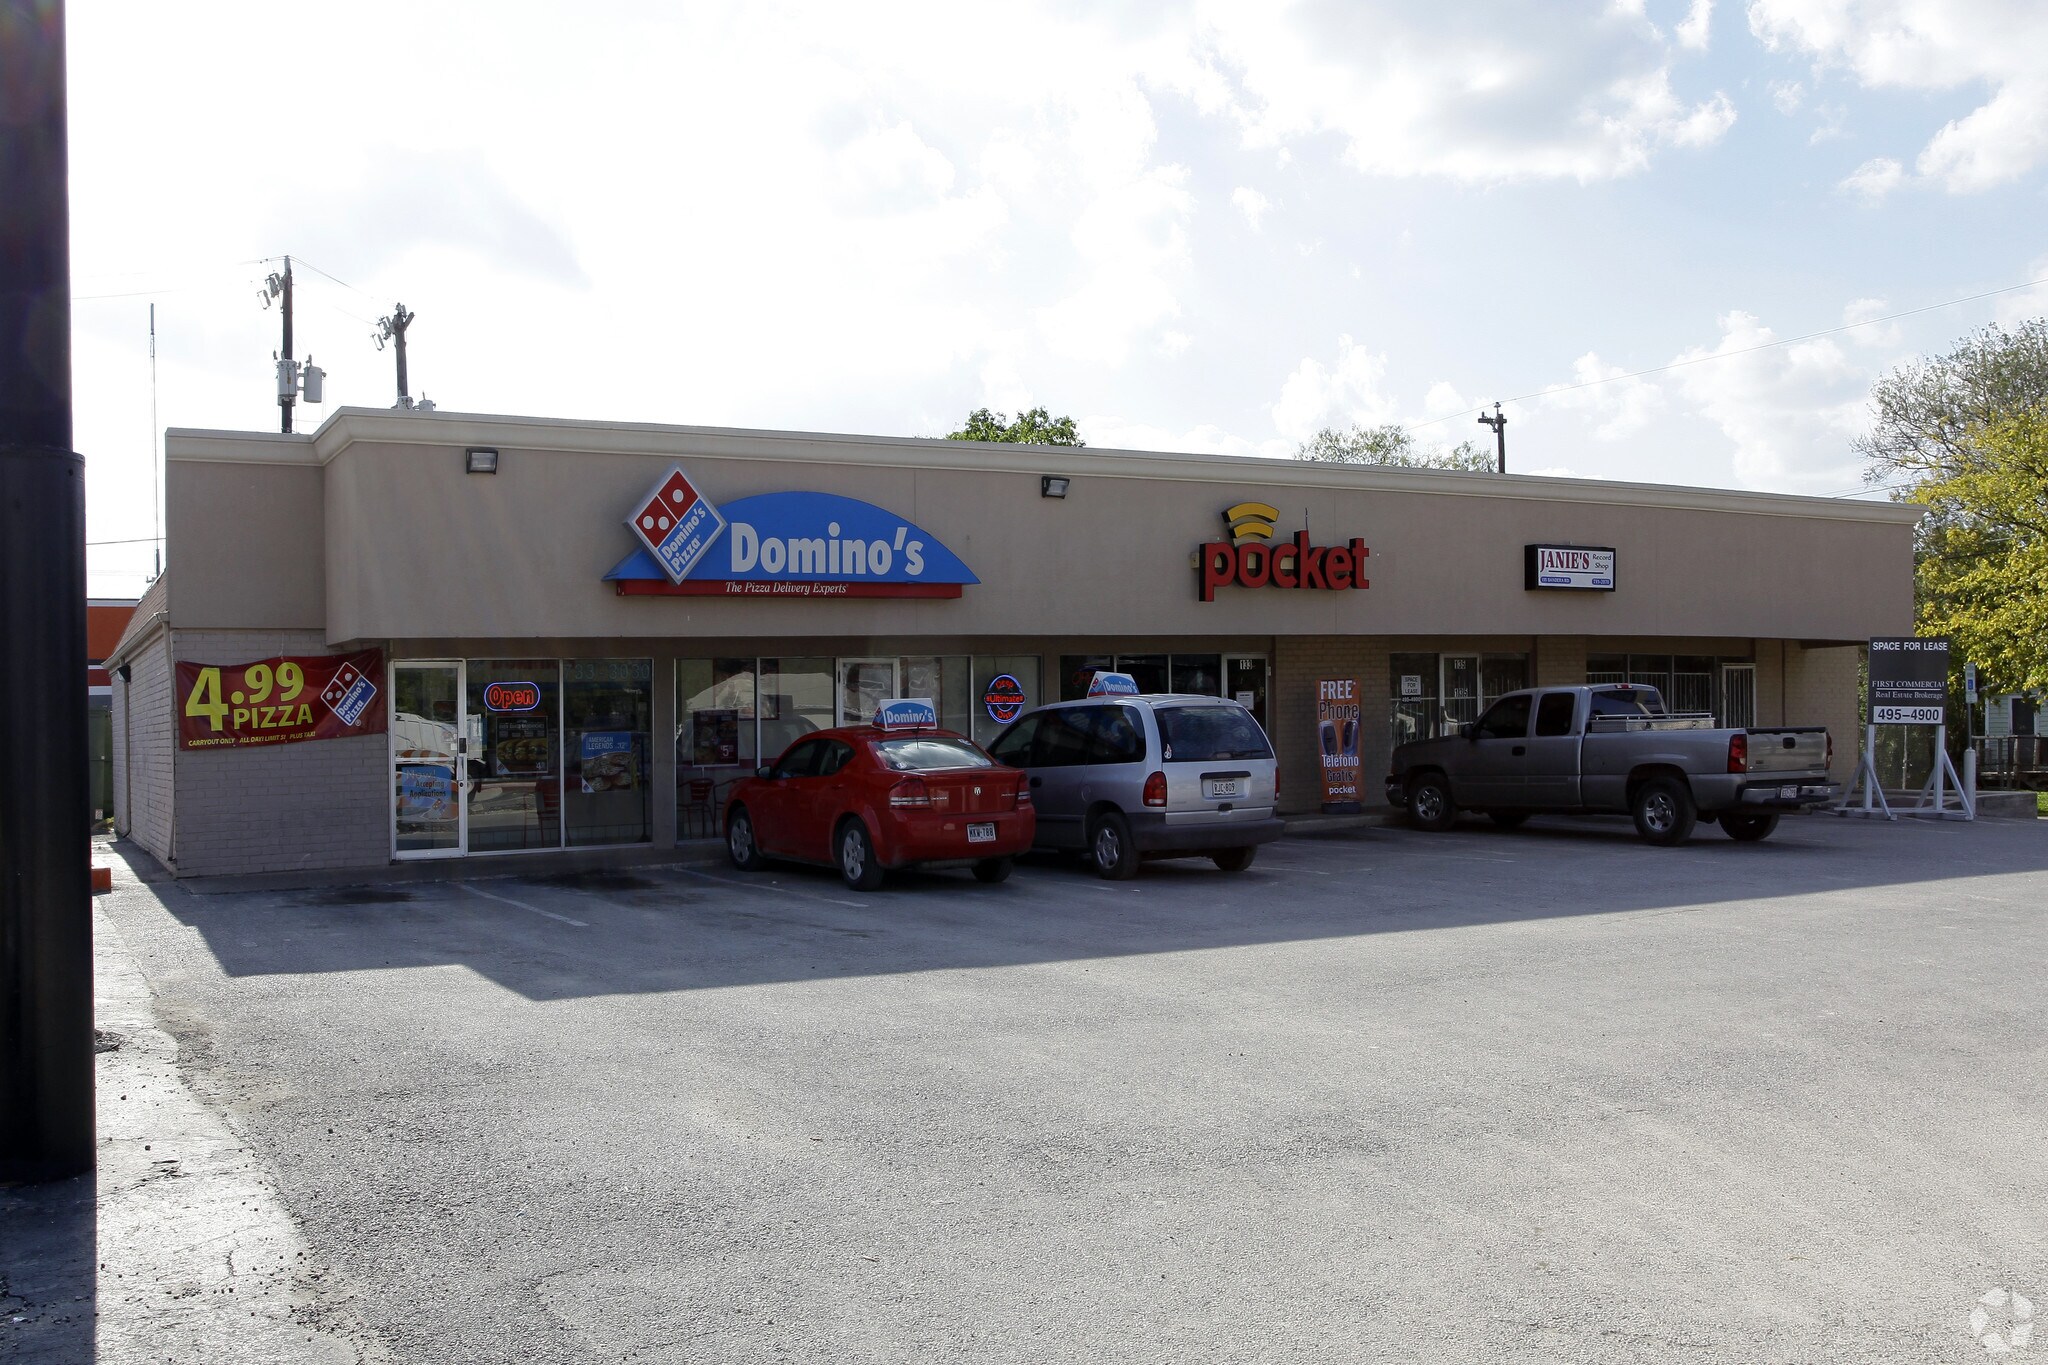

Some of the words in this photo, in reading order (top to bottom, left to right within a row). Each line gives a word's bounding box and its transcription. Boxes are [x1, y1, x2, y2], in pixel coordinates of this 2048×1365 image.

[660, 506, 706, 560] Domino's
[669, 535, 701, 573] Pizza
[731, 521, 925, 576] Domino's
[1540, 550, 1590, 572] JANIE'S
[1592, 553, 1612, 561] Record
[1199, 530, 1369, 602] pocket
[1594, 562, 1609, 570] Shop
[725, 582, 742, 593] The
[744, 582, 770, 593] Pizza
[773, 582, 810, 596] Delivery
[812, 583, 848, 595] Experts
[1872, 641, 1900, 651] SPACE
[1903, 642, 1921, 651] FOR
[1923, 642, 1948, 651] LEASE
[1104, 680, 1138, 694] Domino's
[1320, 680, 1353, 700] FREE
[185, 661, 305, 732] 4.99
[337, 681, 366, 716] Domino's
[489, 685, 534, 708] Open
[1914, 691, 1943, 700] Brokerage
[233, 703, 314, 730] PIZZA
[344, 699, 364, 722] Pizza
[886, 709, 934, 724] Domino's
[997, 710, 1014, 720] Dish
[1320, 701, 1360, 720] Phone
[1878, 708, 1939, 721] 495-4900
[188, 738, 219, 747] CARRYOUT
[220, 737, 235, 745] ONLY
[289, 732, 303, 740] PLUS
[588, 742, 614, 750] LEGENDS
[1326, 769, 1354, 782] Gratis
[410, 789, 447, 800] Applications
[1328, 785, 1356, 795] pocket
